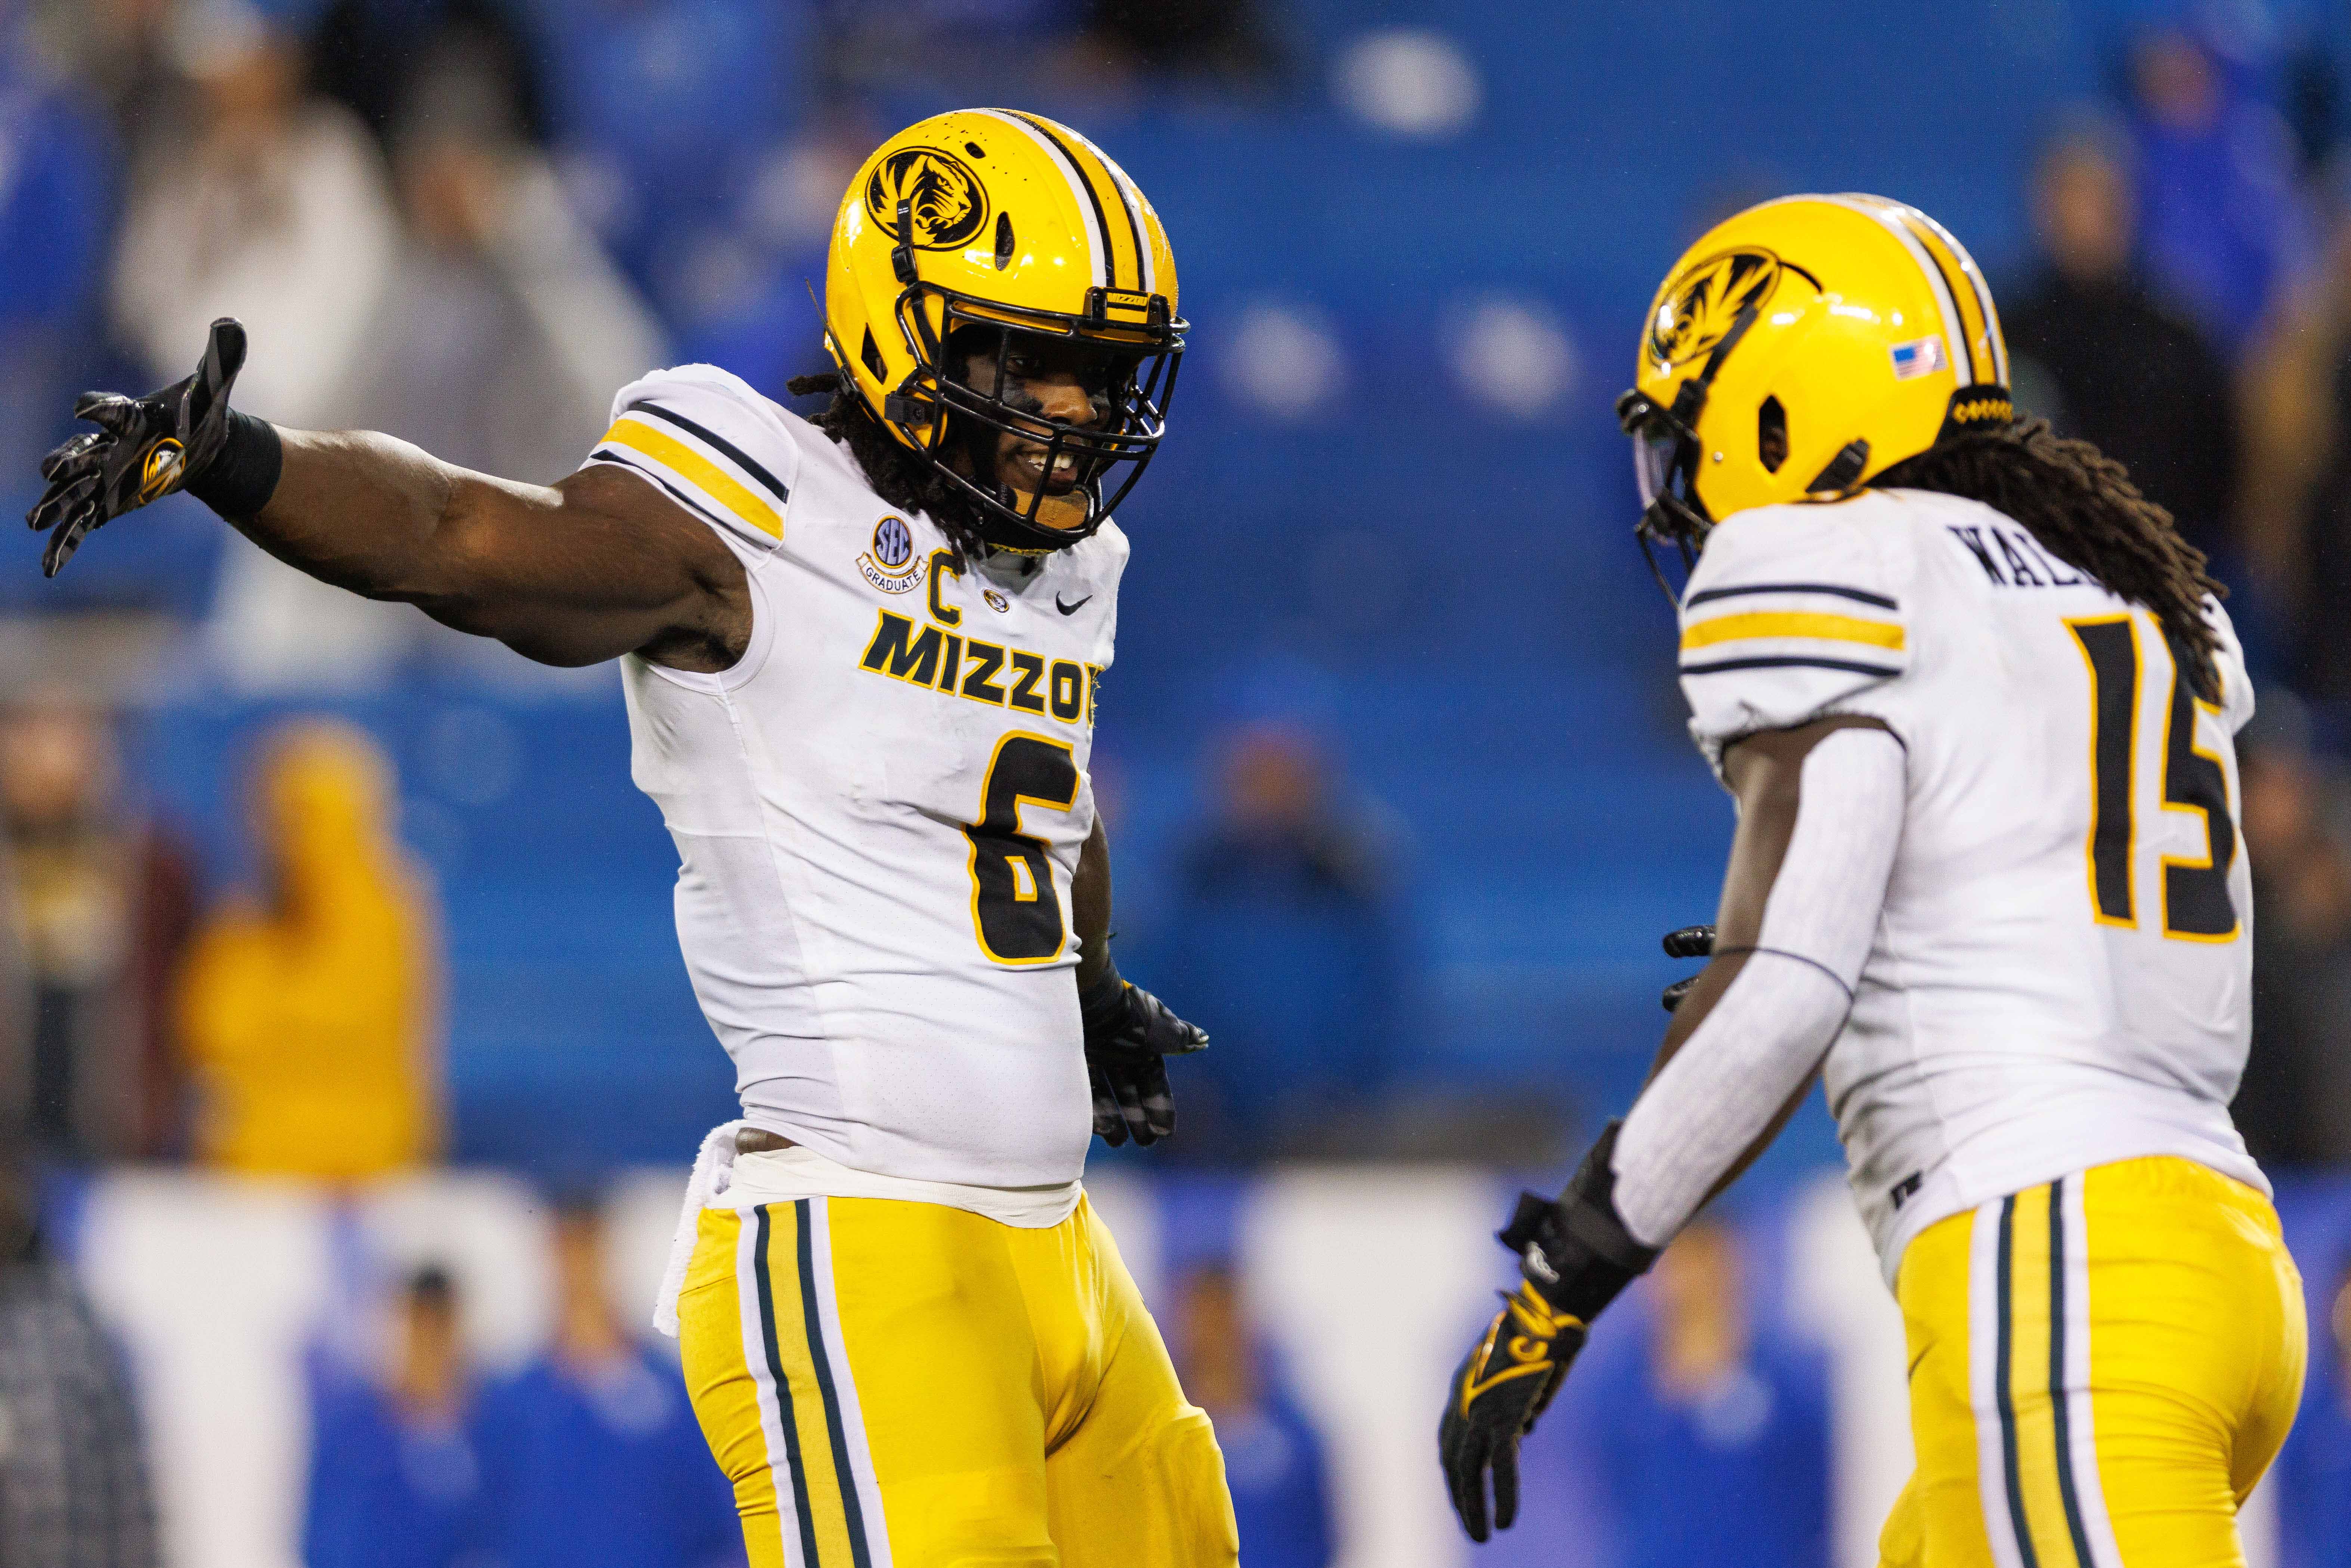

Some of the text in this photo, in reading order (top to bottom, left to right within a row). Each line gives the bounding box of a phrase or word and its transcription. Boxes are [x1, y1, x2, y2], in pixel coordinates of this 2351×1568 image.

[876, 519, 909, 565] SEC
[1945, 524, 2103, 587] WAL
[866, 567, 921, 591] GRADUATE
[927, 547, 963, 628] C
[2060, 610, 2243, 944] 15
[960, 729, 1080, 965] 6
